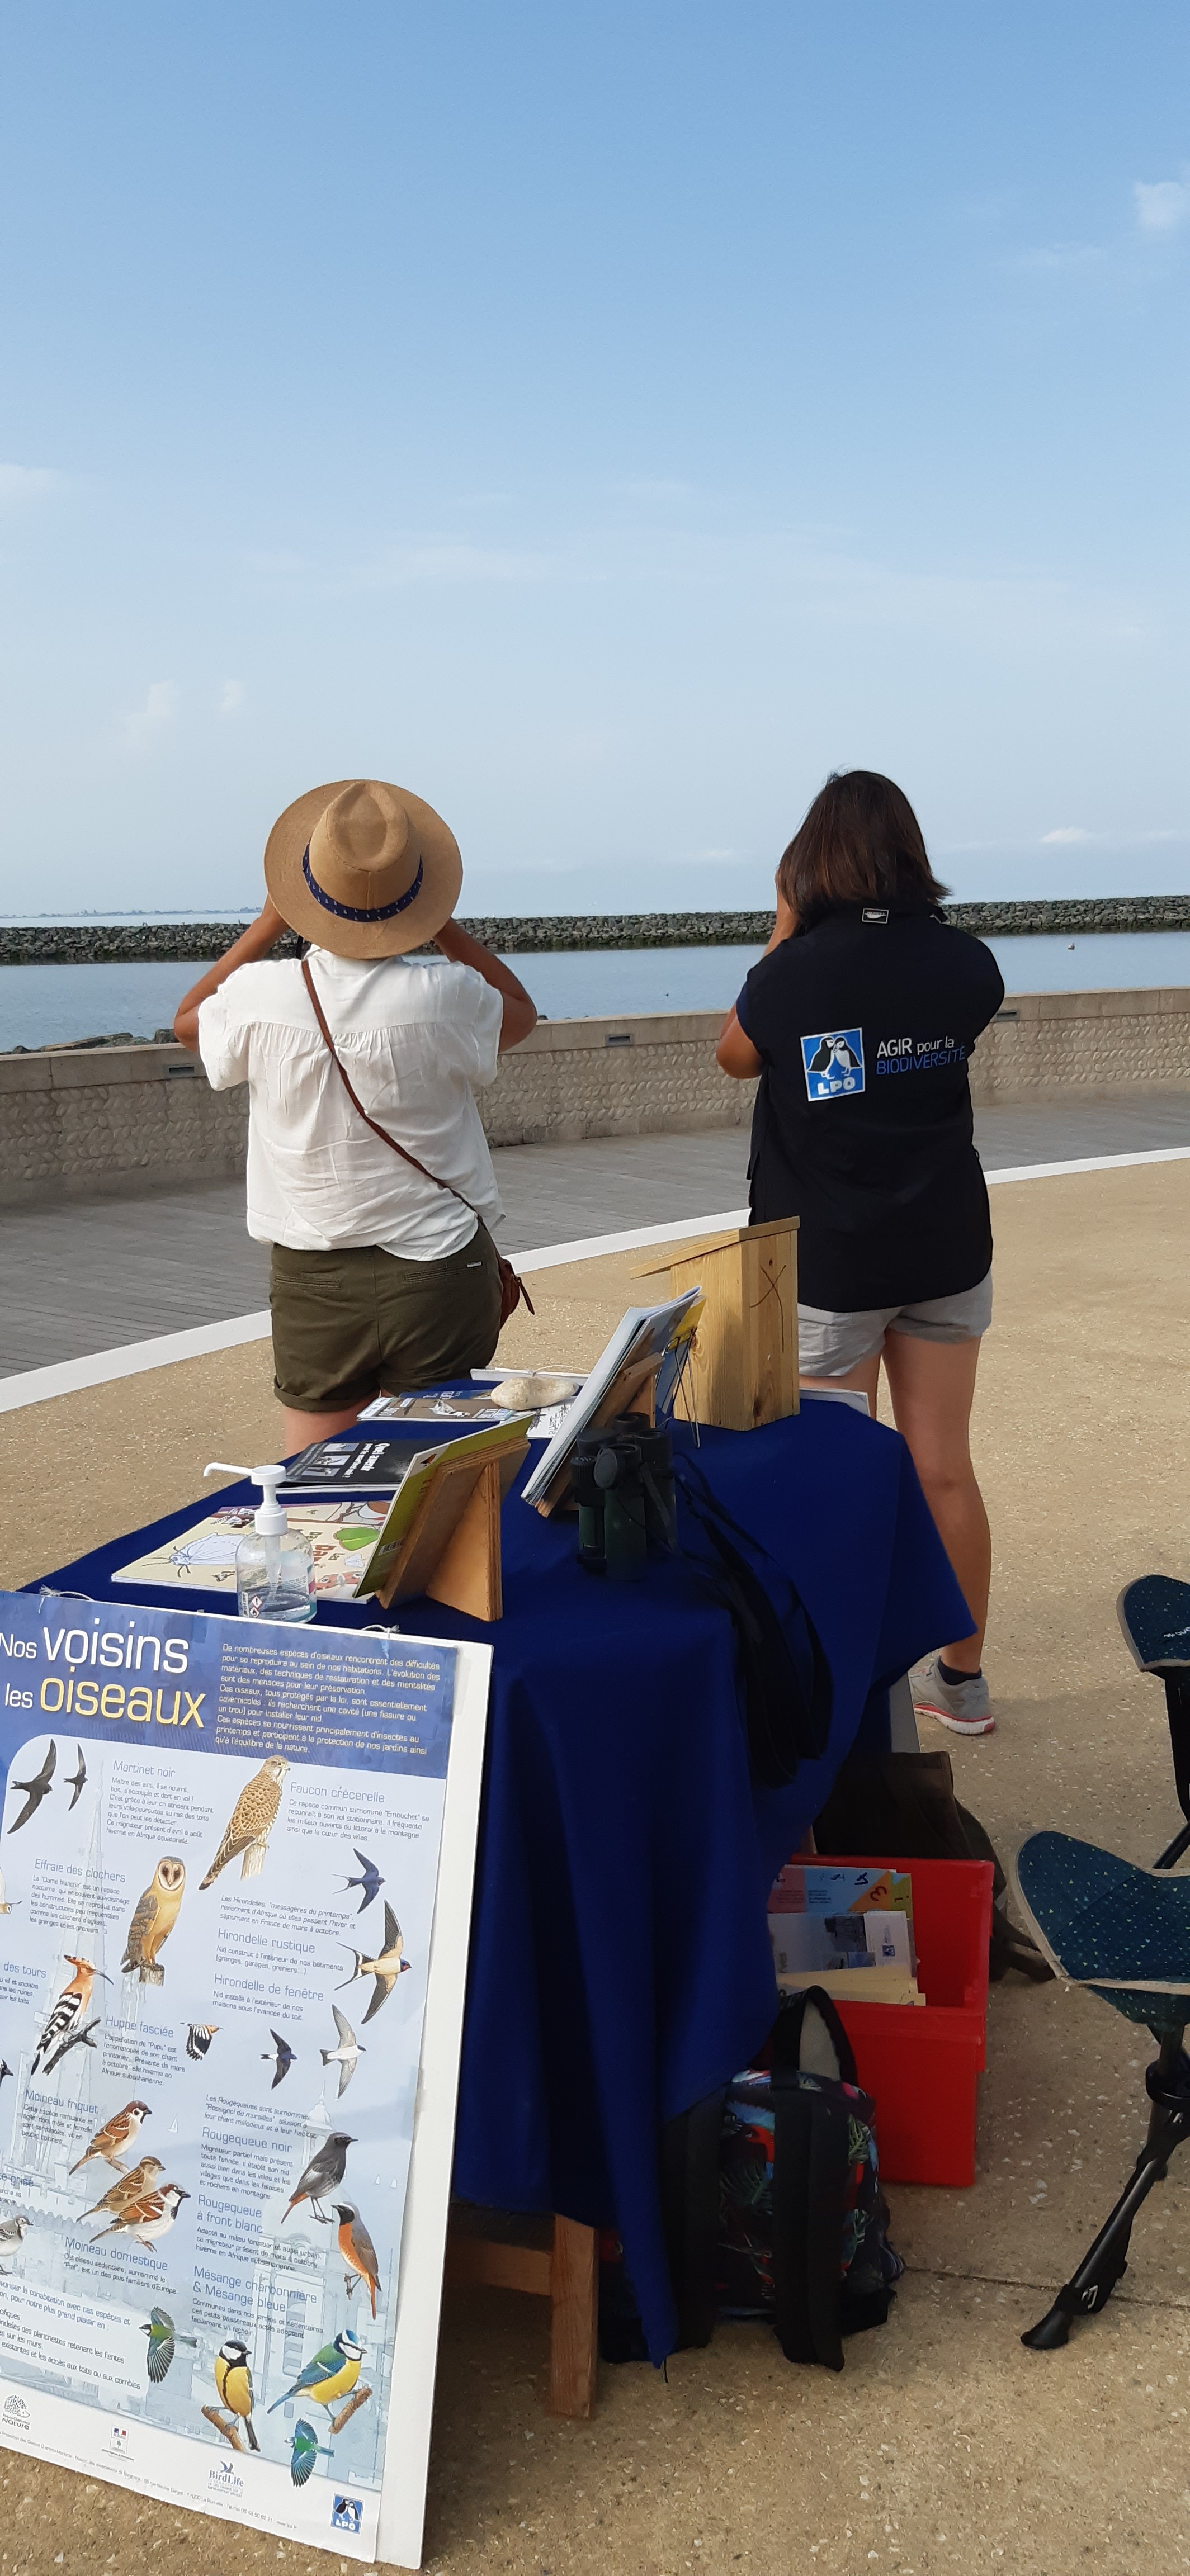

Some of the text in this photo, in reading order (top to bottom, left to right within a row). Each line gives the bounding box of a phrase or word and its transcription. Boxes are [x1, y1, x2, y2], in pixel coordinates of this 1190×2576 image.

[876, 1043, 965, 1074] BIODIVERSITÉ
[877, 1036, 955, 1058] AGIR pour la
[817, 1077, 856, 1095] LPO
[360, 1443, 391, 1471] Quel avenir
[0, 1618, 188, 1674] Nos voisins
[222, 1642, 233, 1651] De
[234, 1646, 277, 1655] nombreuses
[279, 1650, 309, 1658] espèces
[310, 1651, 343, 1661] d'oiseaux
[344, 1655, 388, 1665] rencontrent
[405, 1659, 440, 1670] difficultés
[250, 1658, 287, 1666] reproduire
[386, 1668, 425, 1679] L'évolution
[426, 1671, 440, 1681] des
[259, 1667, 272, 1676] des
[274, 1669, 313, 1680] techniques
[314, 1672, 324, 1680] de
[325, 1674, 370, 1684] restauration
[381, 1678, 395, 1687] des
[396, 1681, 435, 1691] mentalités
[237, 1675, 251, 1684] des
[252, 1678, 284, 1687] menaces
[304, 1681, 318, 1690] leur
[4, 1666, 207, 1727] les oiseaux
[219, 1683, 233, 1693] Ces
[282, 1691, 314, 1702] protégés
[315, 1694, 329, 1703] par
[330, 1694, 337, 1703] la
[369, 1700, 427, 1711] essentiellement
[215, 1726, 251, 1736] printemps
[261, 1731, 300, 1741] participent
[301, 1734, 306, 1742] à
[308, 1734, 315, 1742] la
[316, 1737, 353, 1746] protection
[355, 1739, 365, 1748] de
[382, 1744, 408, 1753] jardins
[216, 1714, 230, 1723] Ces
[232, 1717, 261, 1726] espèces
[273, 1722, 314, 1732] nourrissent
[315, 1726, 369, 1737] principalement
[370, 1730, 408, 1742] d'insectes
[215, 1735, 229, 1745] qu'à
[231, 1736, 263, 1748] l'équilibre
[265, 1740, 274, 1749] de
[276, 1741, 282, 1750] la
[113, 1760, 176, 1777] Martinet noir
[290, 1781, 385, 1803] Faucon crécerelle
[34, 1858, 125, 1882] Effraie des clochers
[218, 1928, 315, 1954] Hirondelle rustique
[3, 1961, 46, 1978] des tours
[214, 1973, 324, 2001] Hirondelle de fenêtre
[105, 2015, 174, 2038] Huppe fasciée
[25, 2089, 98, 2114] Moineau friquet
[202, 2126, 292, 2152] Rougequeue noir
[10, 2175, 34, 2187] grise
[197, 2194, 262, 2218] Rougequeue
[196, 2210, 263, 2234] à front blanc
[65, 2236, 168, 2271] Moineau domestique
[192, 2280, 286, 2312] & Mésange bleue
[193, 2265, 317, 2303] Mésange charbonnière
[2, 2417, 30, 2430] Nature
[209, 2469, 244, 2487] BirdLife
[336, 2518, 356, 2531] LPO
